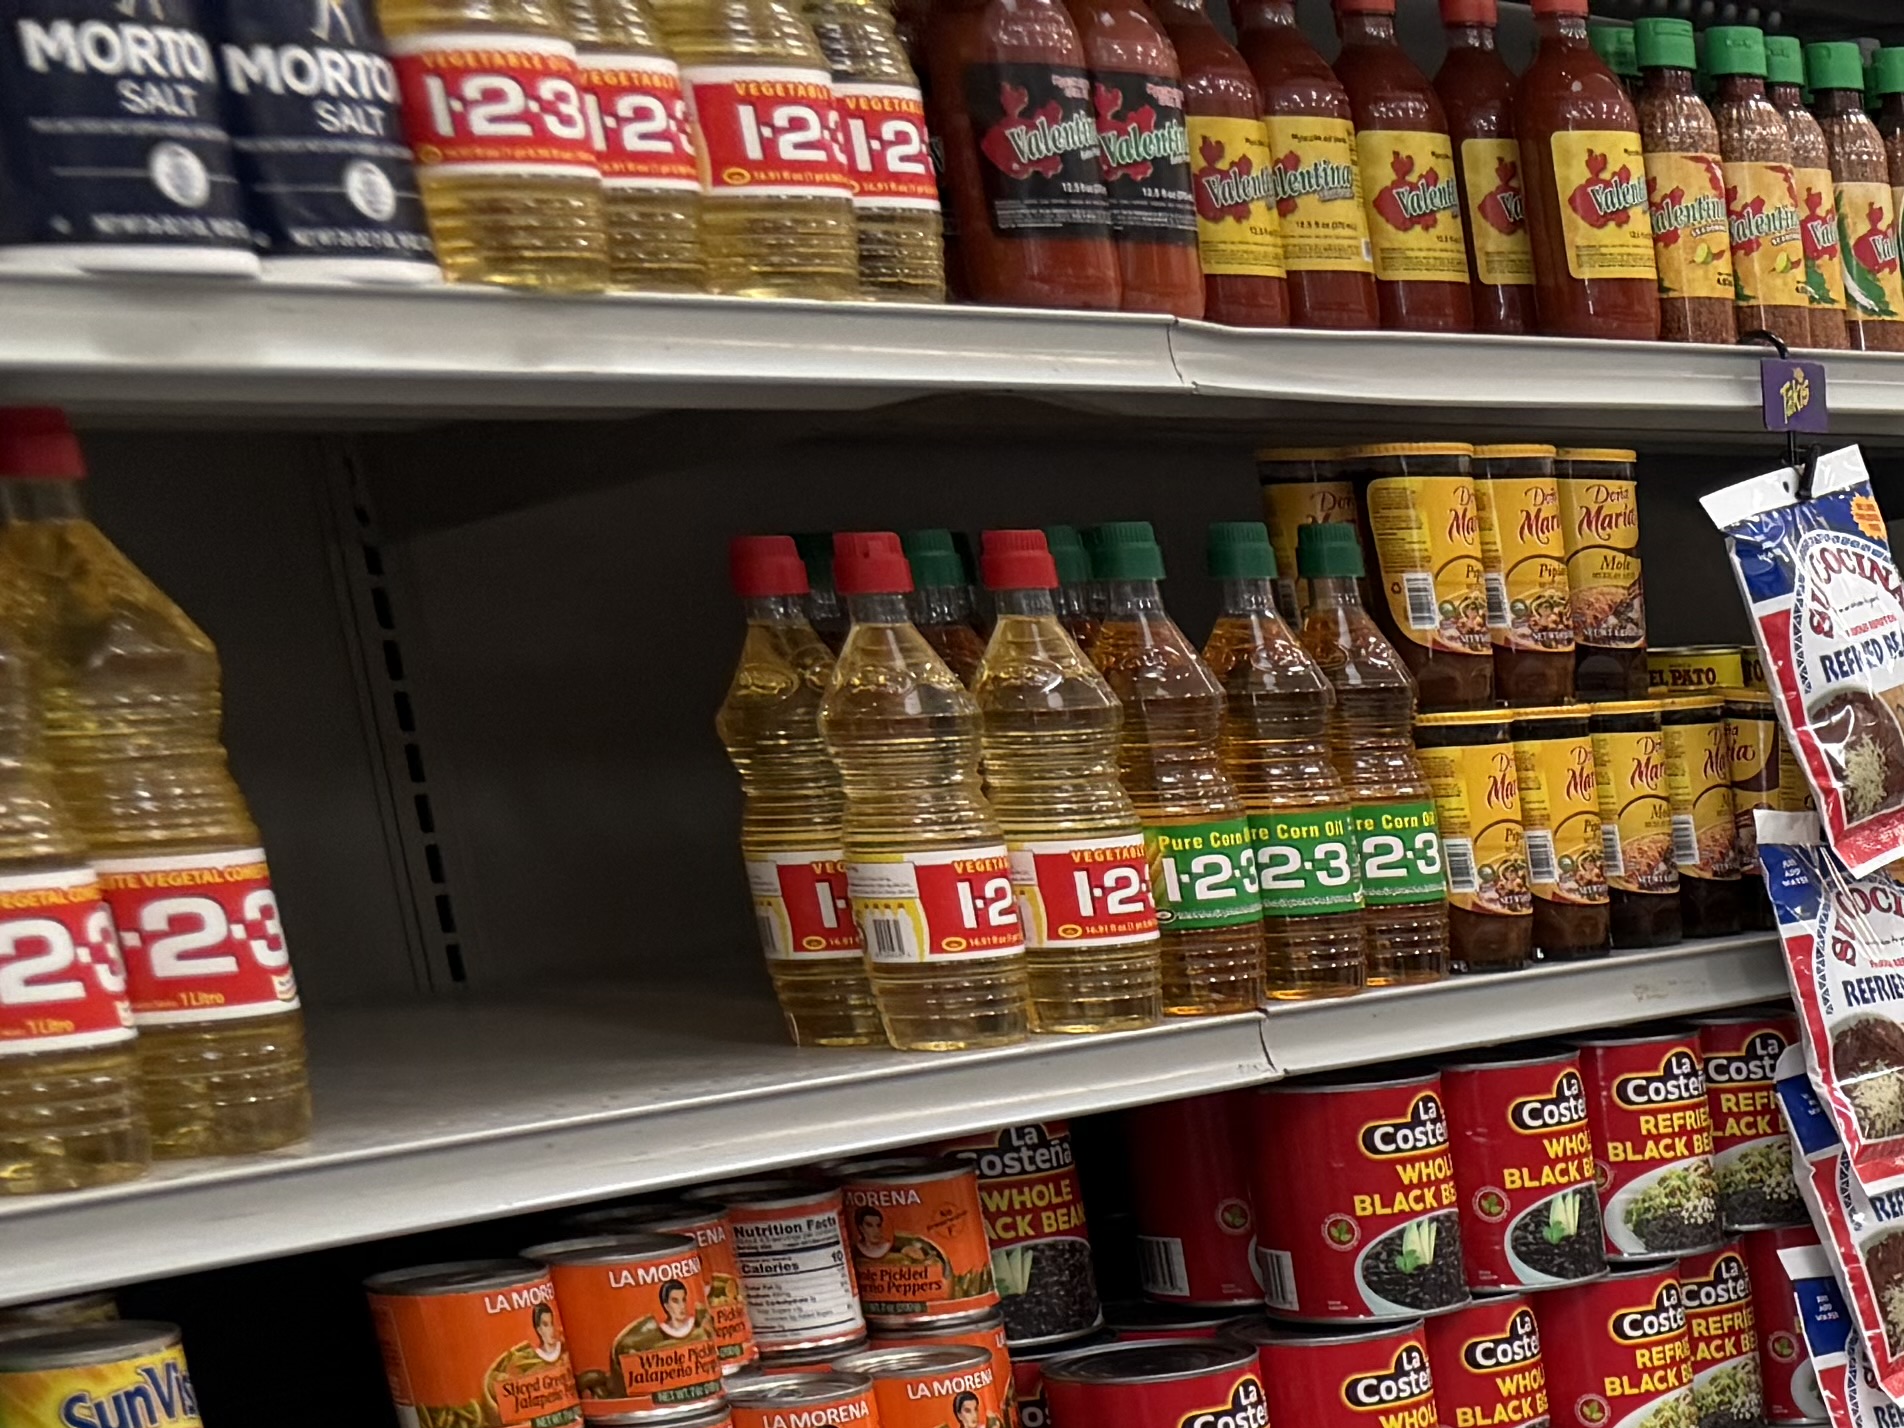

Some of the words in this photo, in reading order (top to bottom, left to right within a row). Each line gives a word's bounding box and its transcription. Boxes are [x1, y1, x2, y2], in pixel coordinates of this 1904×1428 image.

[117, 79, 198, 118] SALT
[317, 101, 386, 138] SALT
[1648, 667, 1671, 688] EL
[1673, 665, 1718, 688] PATO
[1276, 819, 1319, 843] Corn
[1323, 816, 1345, 839] Oil
[1373, 812, 1417, 833] Corn
[1158, 831, 1200, 853] Pure
[1204, 827, 1244, 850] Corn
[145, 870, 222, 888] VEGETAL
[1670, 1055, 1692, 1076] La
[1419, 1100, 1438, 1122] La
[1607, 1134, 1672, 1163] BLACK
[1354, 1185, 1436, 1216] BLACK
[732, 1217, 801, 1242] Nutrition
[803, 1214, 838, 1233] Facts
[608, 1266, 633, 1289] LA
[741, 1258, 801, 1278] Calories
[1402, 1349, 1423, 1371] La
[906, 1379, 931, 1400] LA
[932, 1367, 994, 1396] MORENA
[789, 1399, 870, 1428] MORENA
